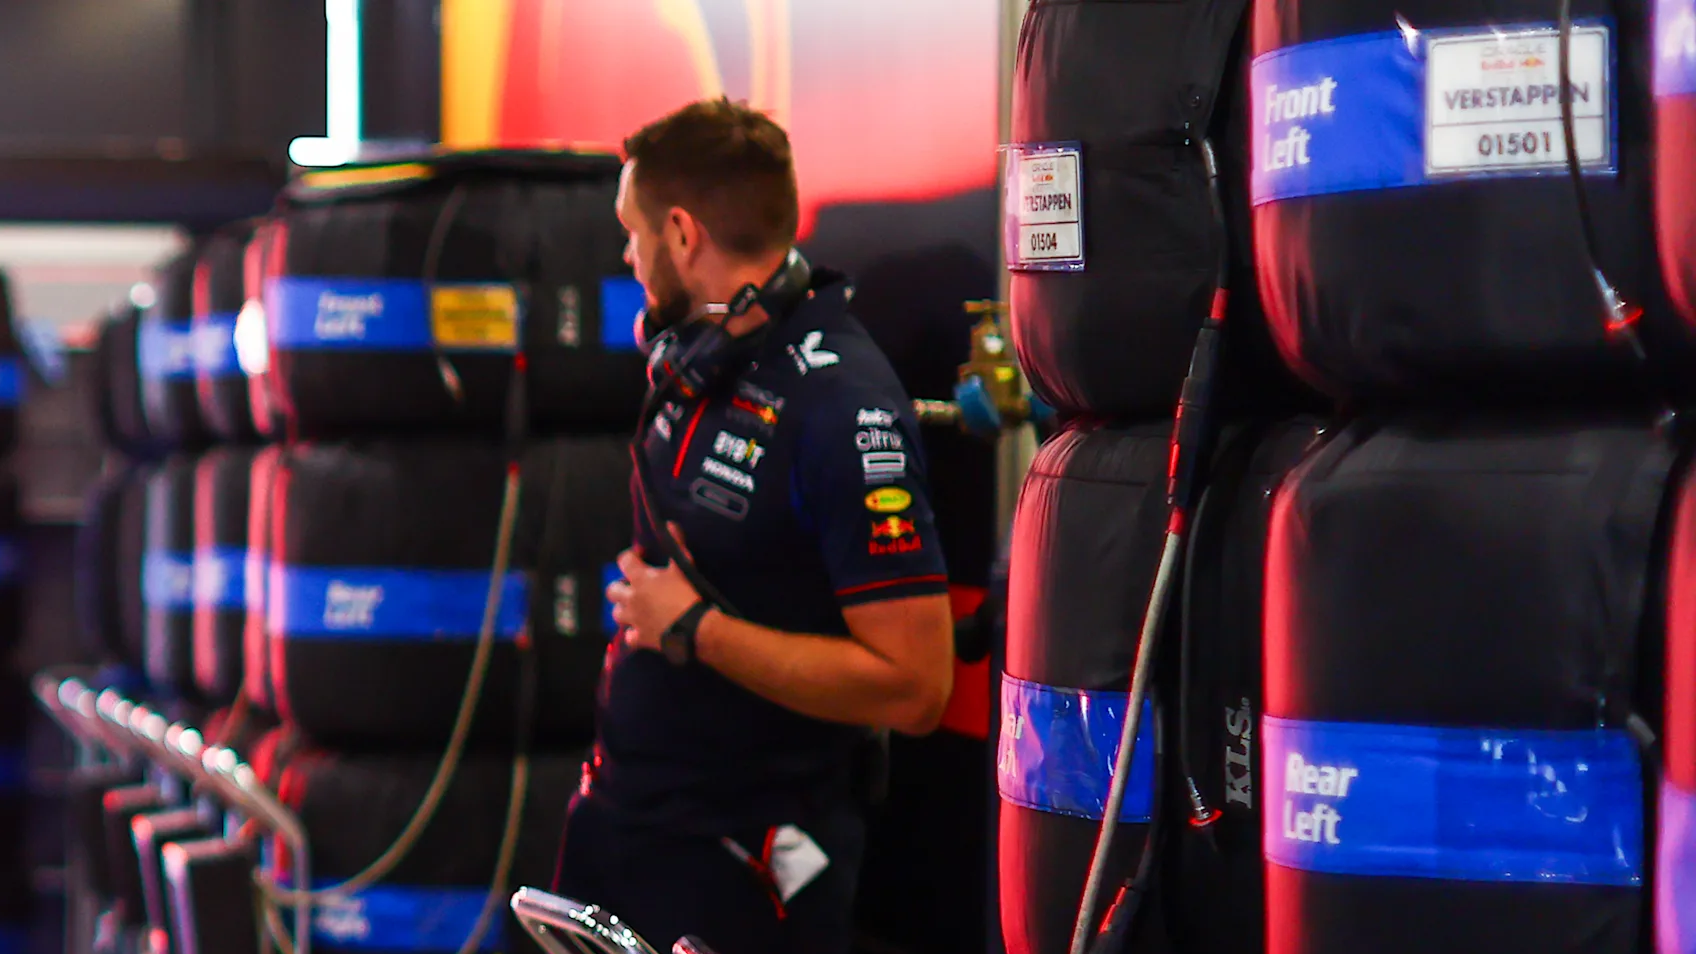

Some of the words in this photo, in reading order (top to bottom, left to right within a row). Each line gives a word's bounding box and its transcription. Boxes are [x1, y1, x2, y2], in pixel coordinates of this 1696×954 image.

[1264, 76, 1338, 125] Front
[1444, 82, 1590, 110] VERSTAPPN
[1264, 125, 1311, 172] Left
[1478, 131, 1552, 157] 01501
[1031, 233, 1057, 251] 01504
[1226, 705, 1253, 810] KLS
[1285, 751, 1359, 797] Rear
[1283, 799, 1342, 845] Left
